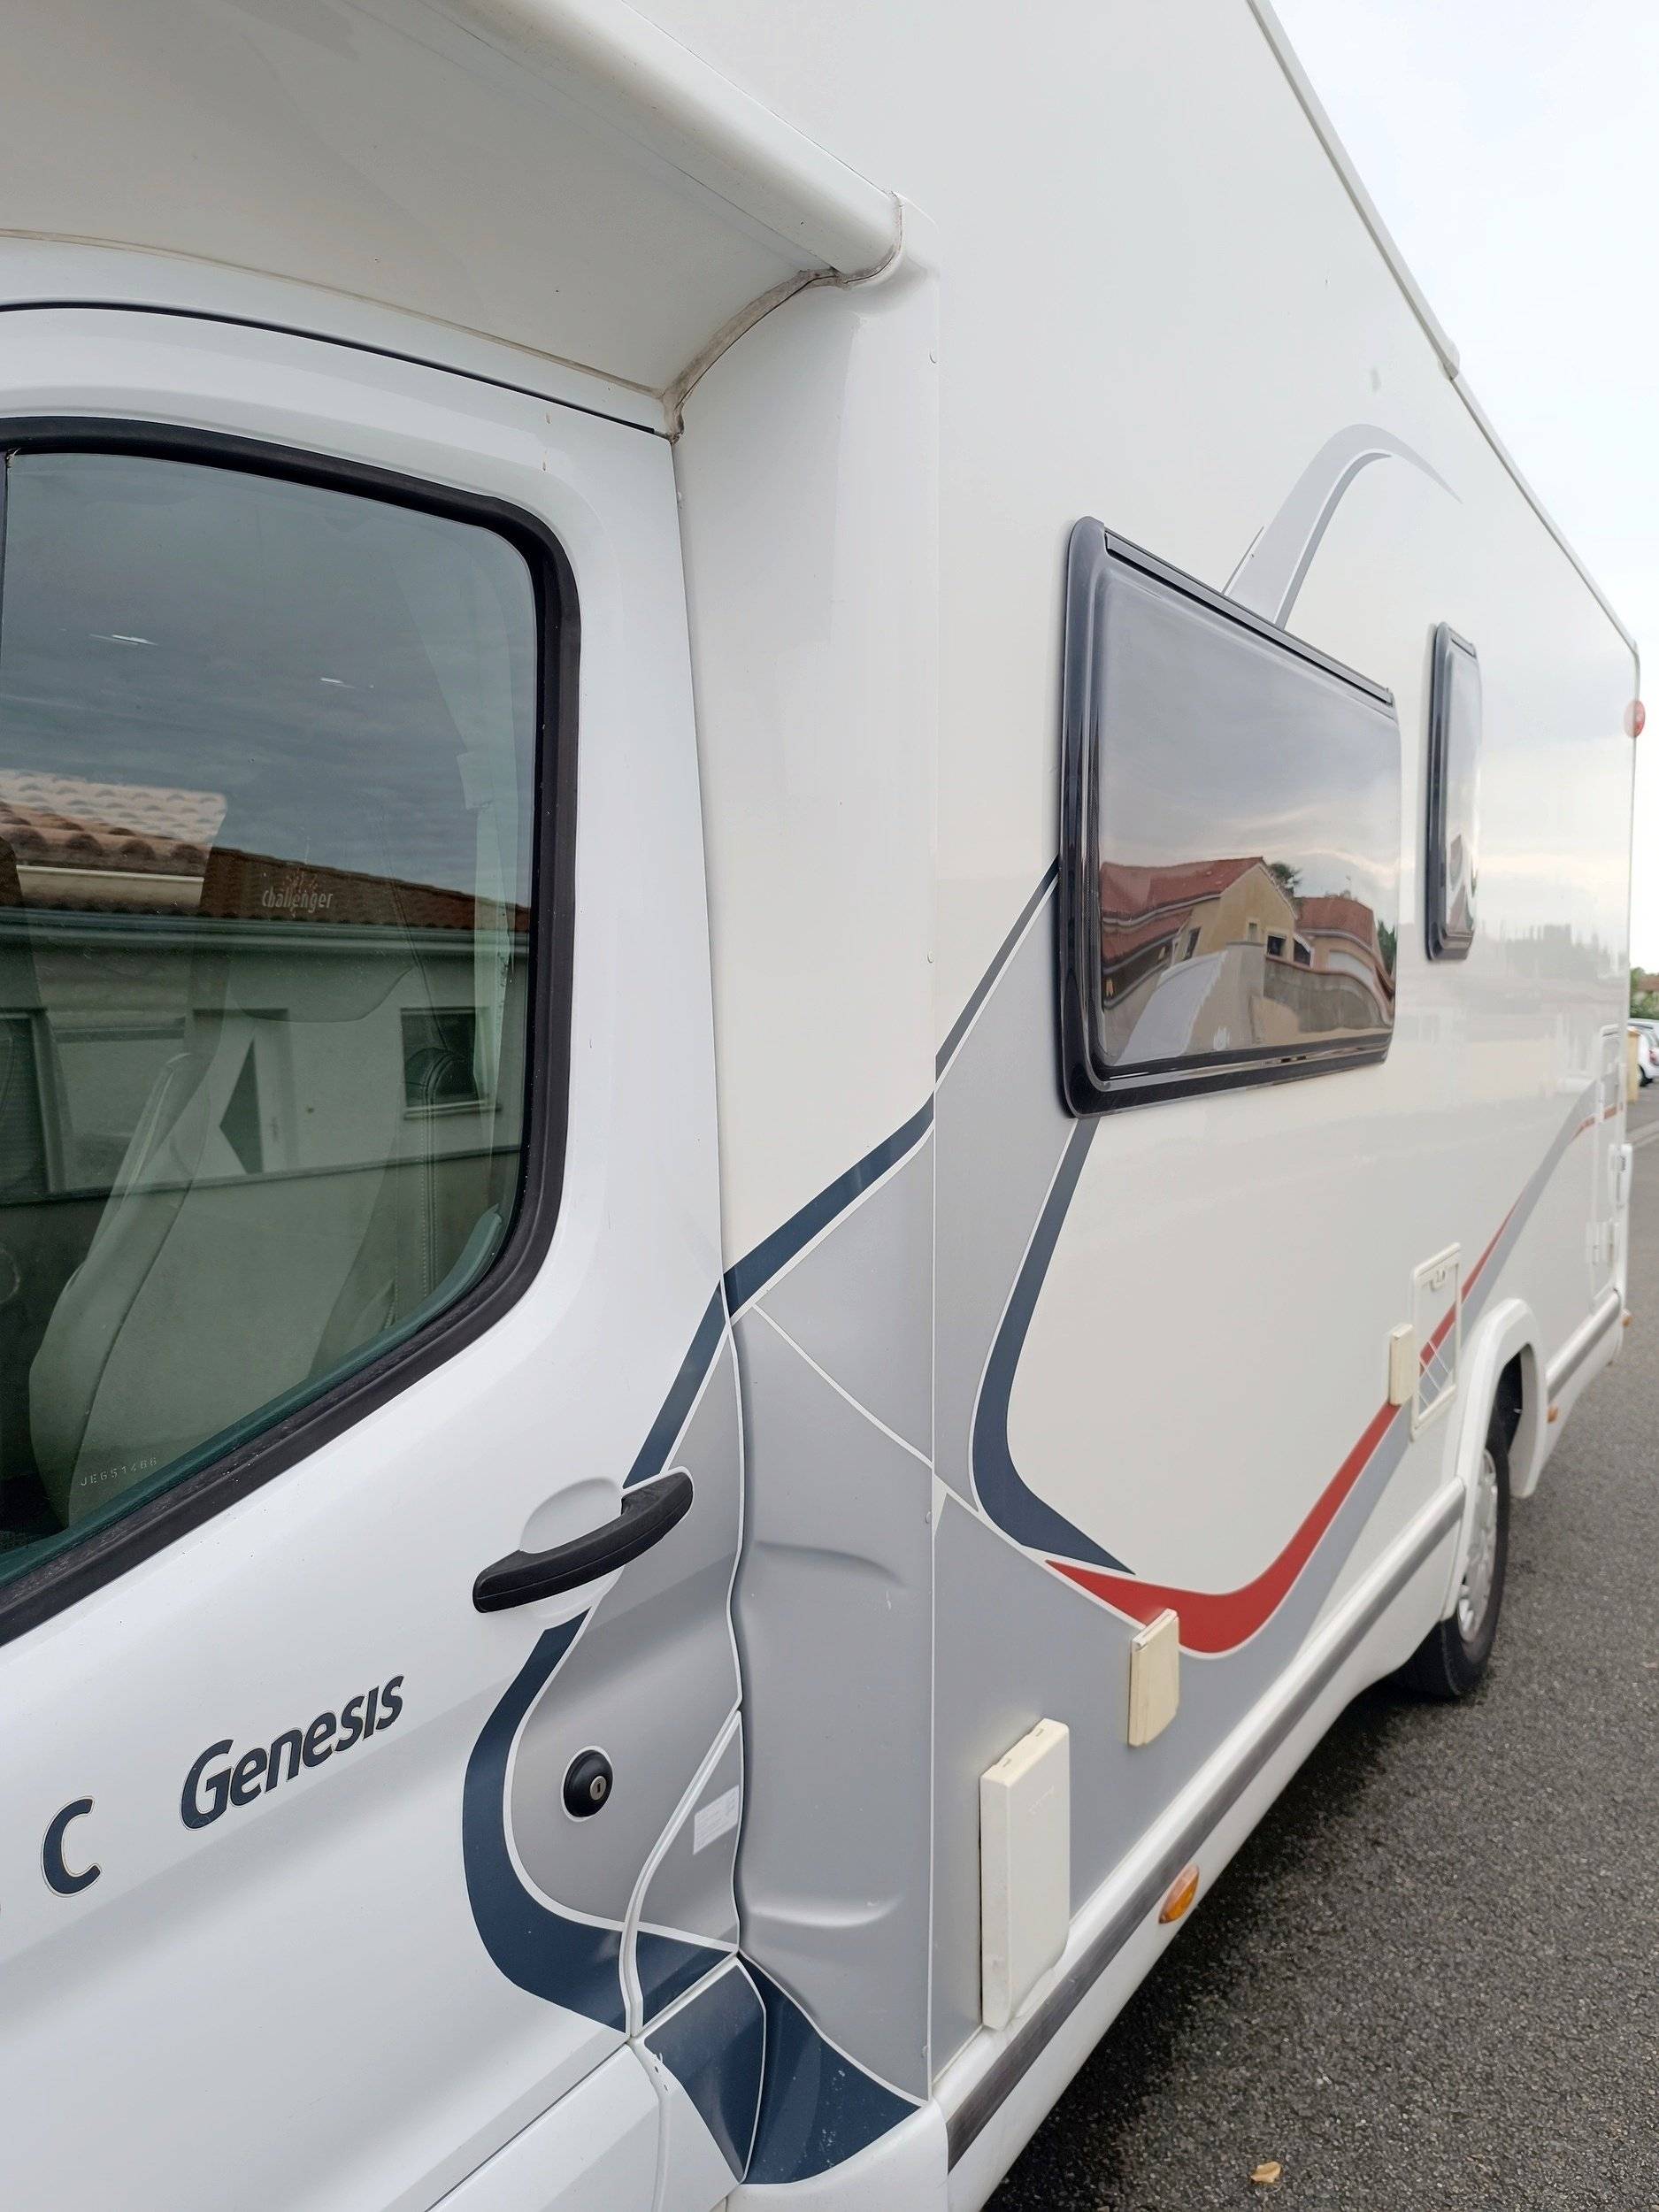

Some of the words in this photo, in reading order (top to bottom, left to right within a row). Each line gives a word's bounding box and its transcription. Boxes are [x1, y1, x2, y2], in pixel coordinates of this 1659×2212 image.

[262, 886, 334, 913] challenger
[42, 1797, 101, 1895] C
[180, 1674, 404, 1830] Genesis
